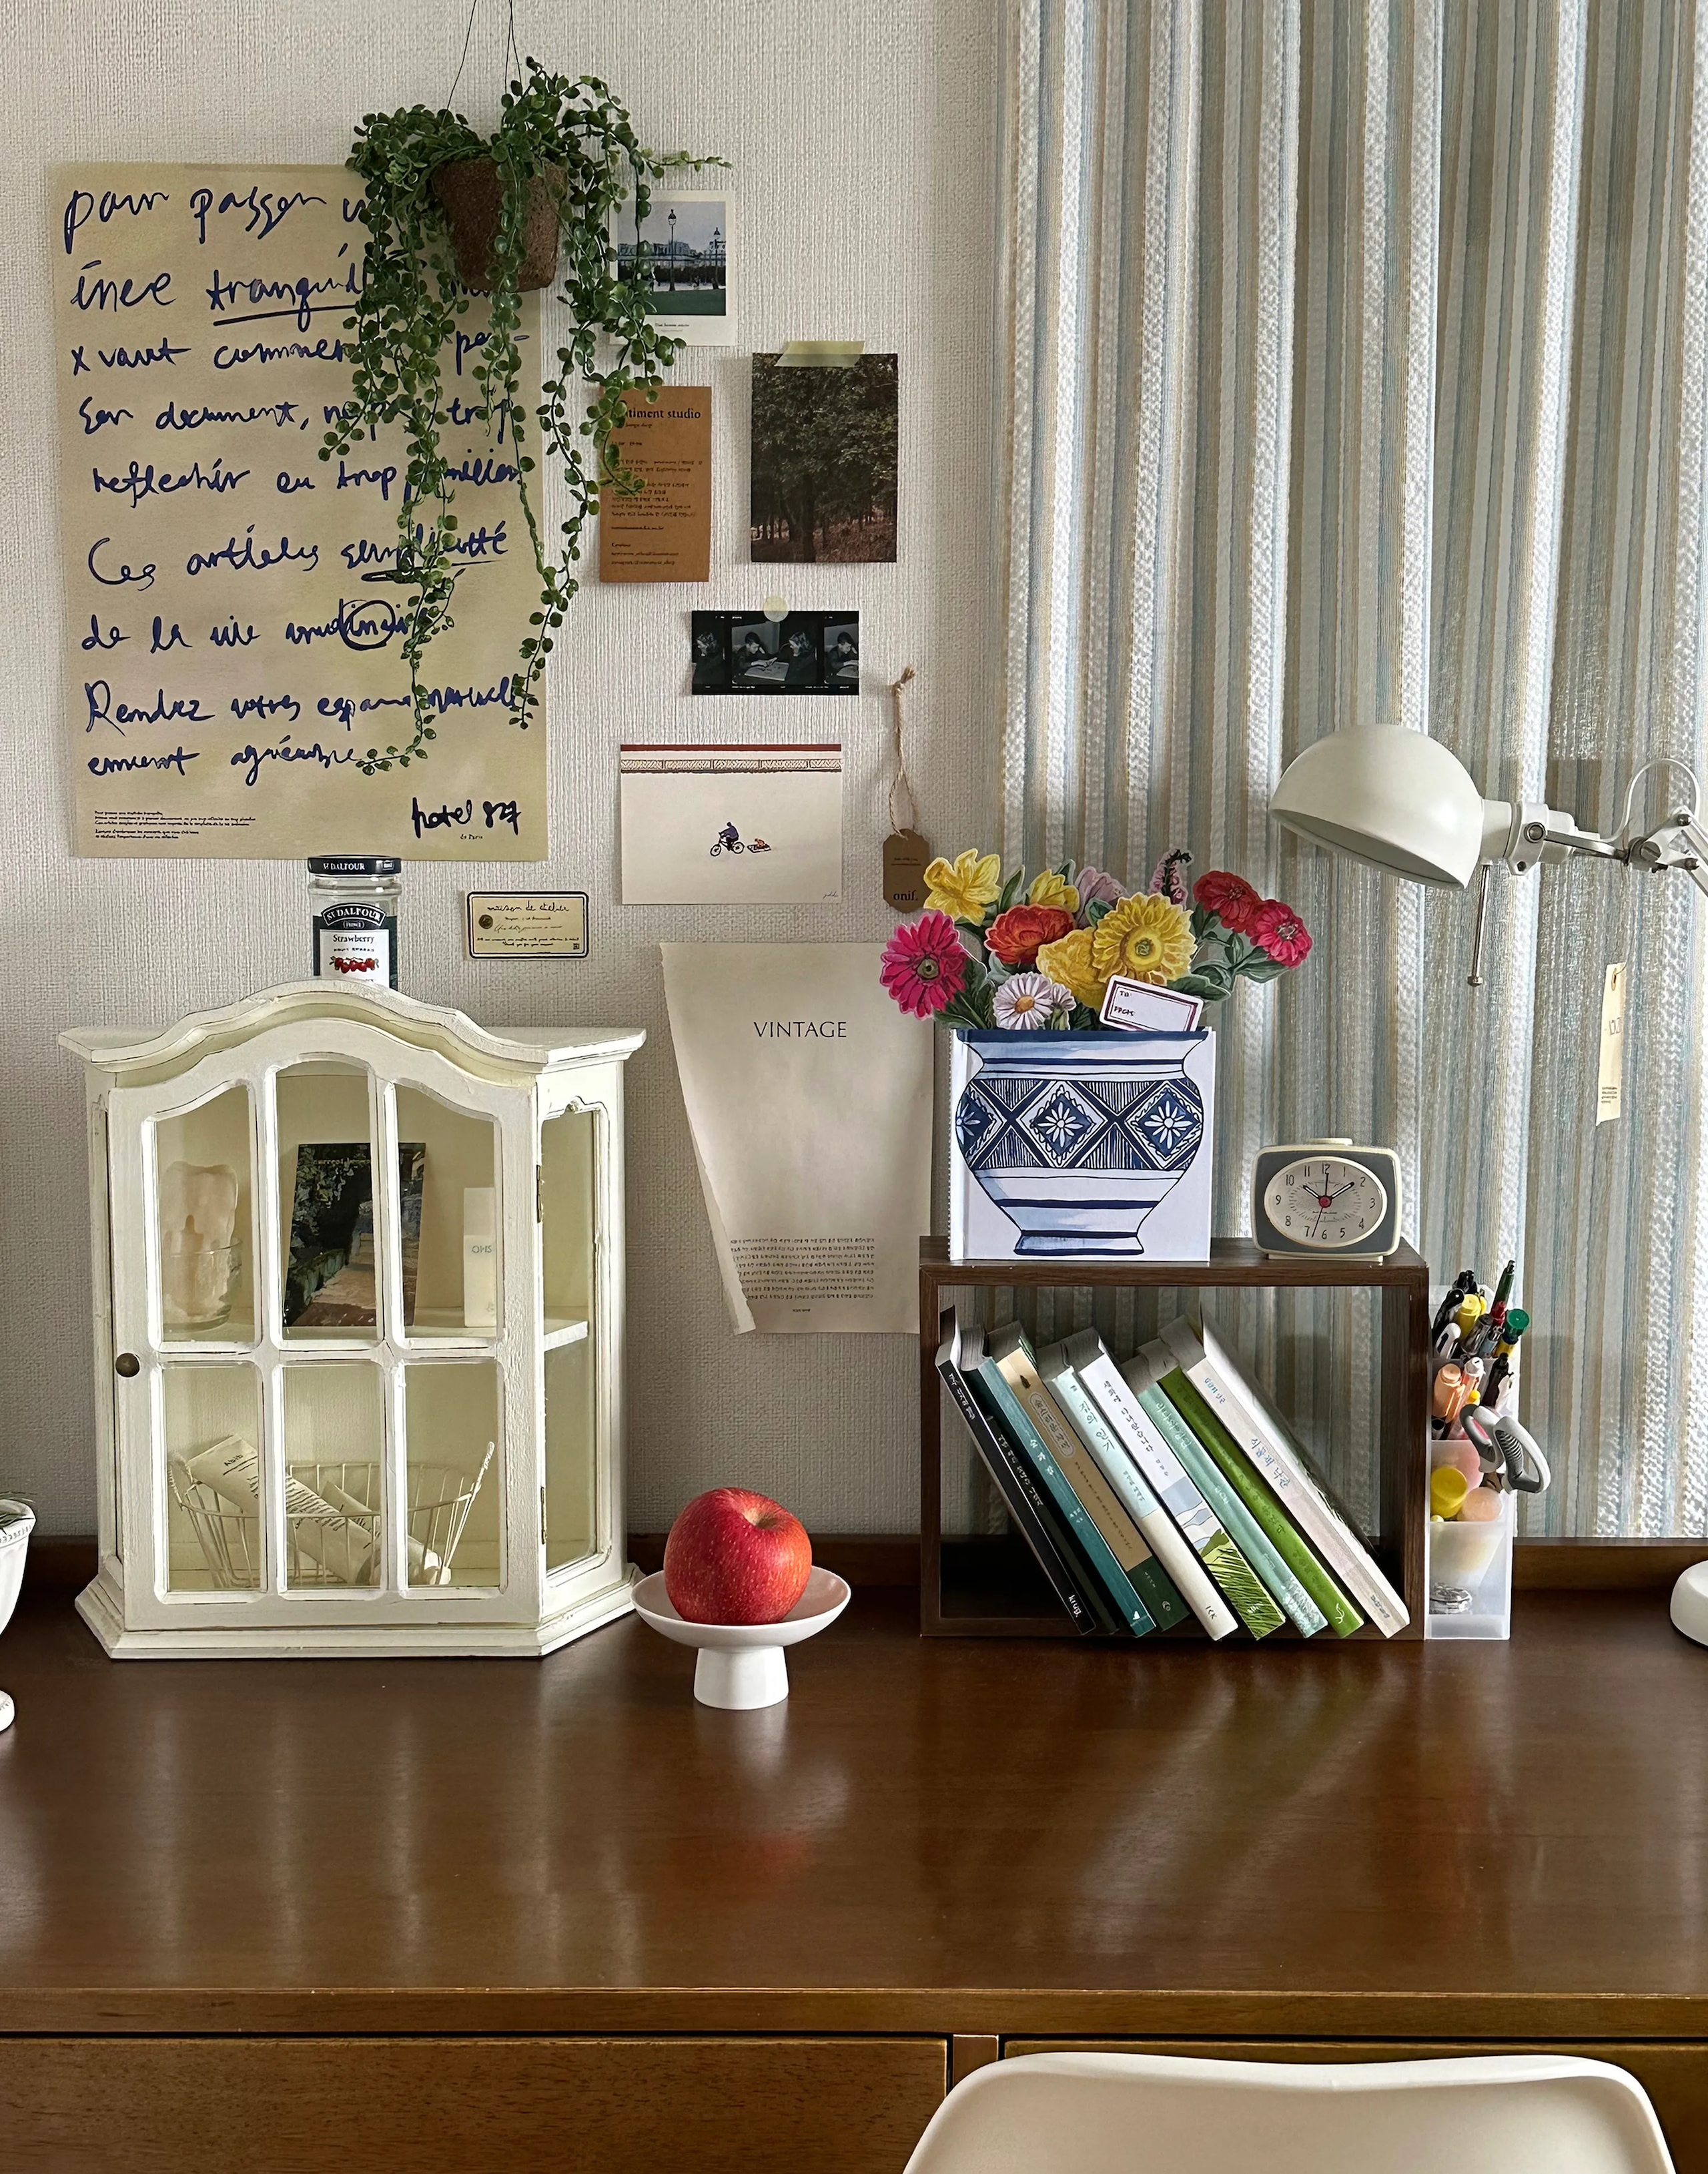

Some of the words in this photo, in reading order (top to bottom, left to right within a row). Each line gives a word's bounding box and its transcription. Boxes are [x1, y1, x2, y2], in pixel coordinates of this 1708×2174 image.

[624, 408, 665, 419] timent
[667, 408, 701, 420] studio
[333, 934, 375, 944] Strawberry
[753, 1021, 847, 1038] VINTAGE
[1304, 1165, 1310, 1177] 11
[1322, 1164, 1330, 1174] 12
[1285, 1174, 1294, 1186] 10
[1360, 1176, 1366, 1187] 2
[1276, 1194, 1282, 1205] 9
[1369, 1198, 1376, 1209] 3
[1285, 1215, 1292, 1226] 8
[1358, 1217, 1364, 1230] 4
[1304, 1225, 1310, 1237] 7
[1321, 1229, 1328, 1240] 6
[1340, 1228, 1346, 1238] 5
